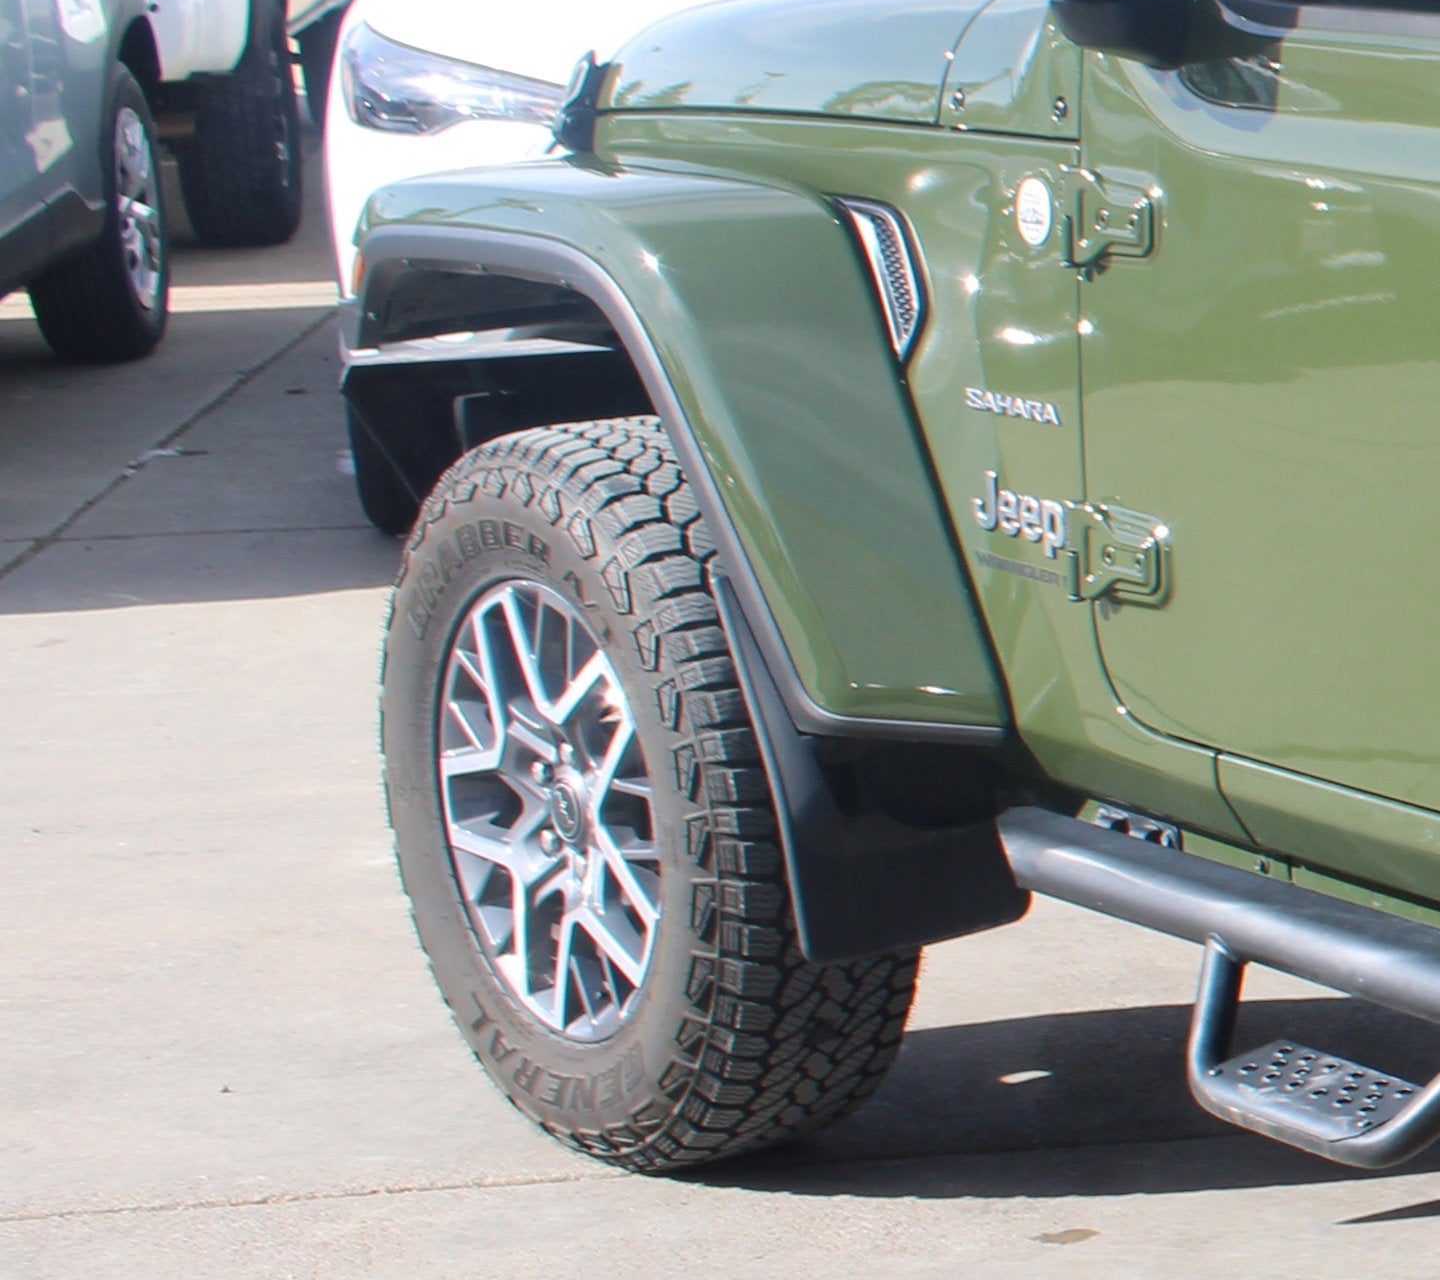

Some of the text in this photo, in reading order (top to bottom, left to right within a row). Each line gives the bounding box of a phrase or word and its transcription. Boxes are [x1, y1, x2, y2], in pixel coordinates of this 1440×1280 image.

[964, 387, 1062, 426] SAHARA
[972, 470, 1067, 559] Jeep
[407, 516, 551, 641] GRABBER
[471, 990, 646, 1114] GENERAL
